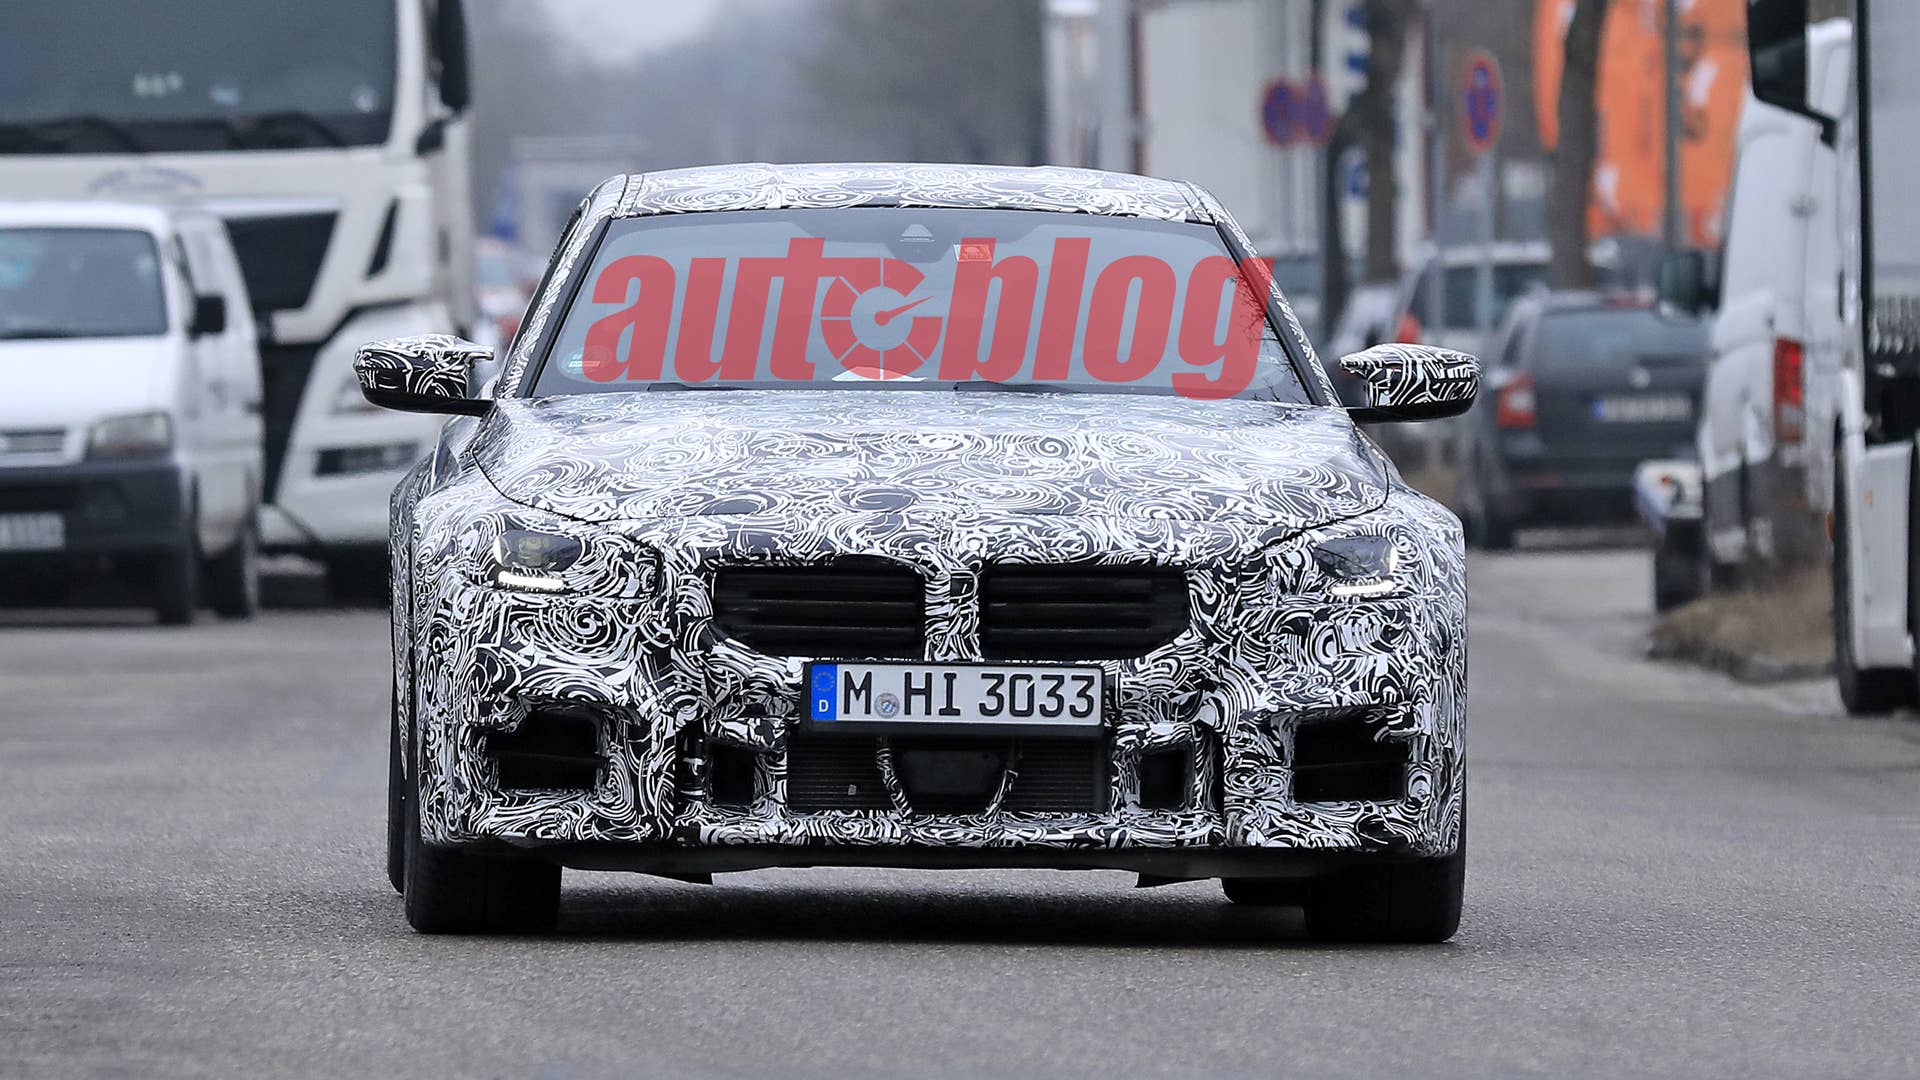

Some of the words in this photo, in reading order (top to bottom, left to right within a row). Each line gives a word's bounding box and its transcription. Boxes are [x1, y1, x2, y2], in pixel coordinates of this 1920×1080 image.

[818, 699, 829, 713] D
[843, 670, 872, 715] M
[904, 672, 961, 716] HI
[978, 672, 1095, 718] 3033
